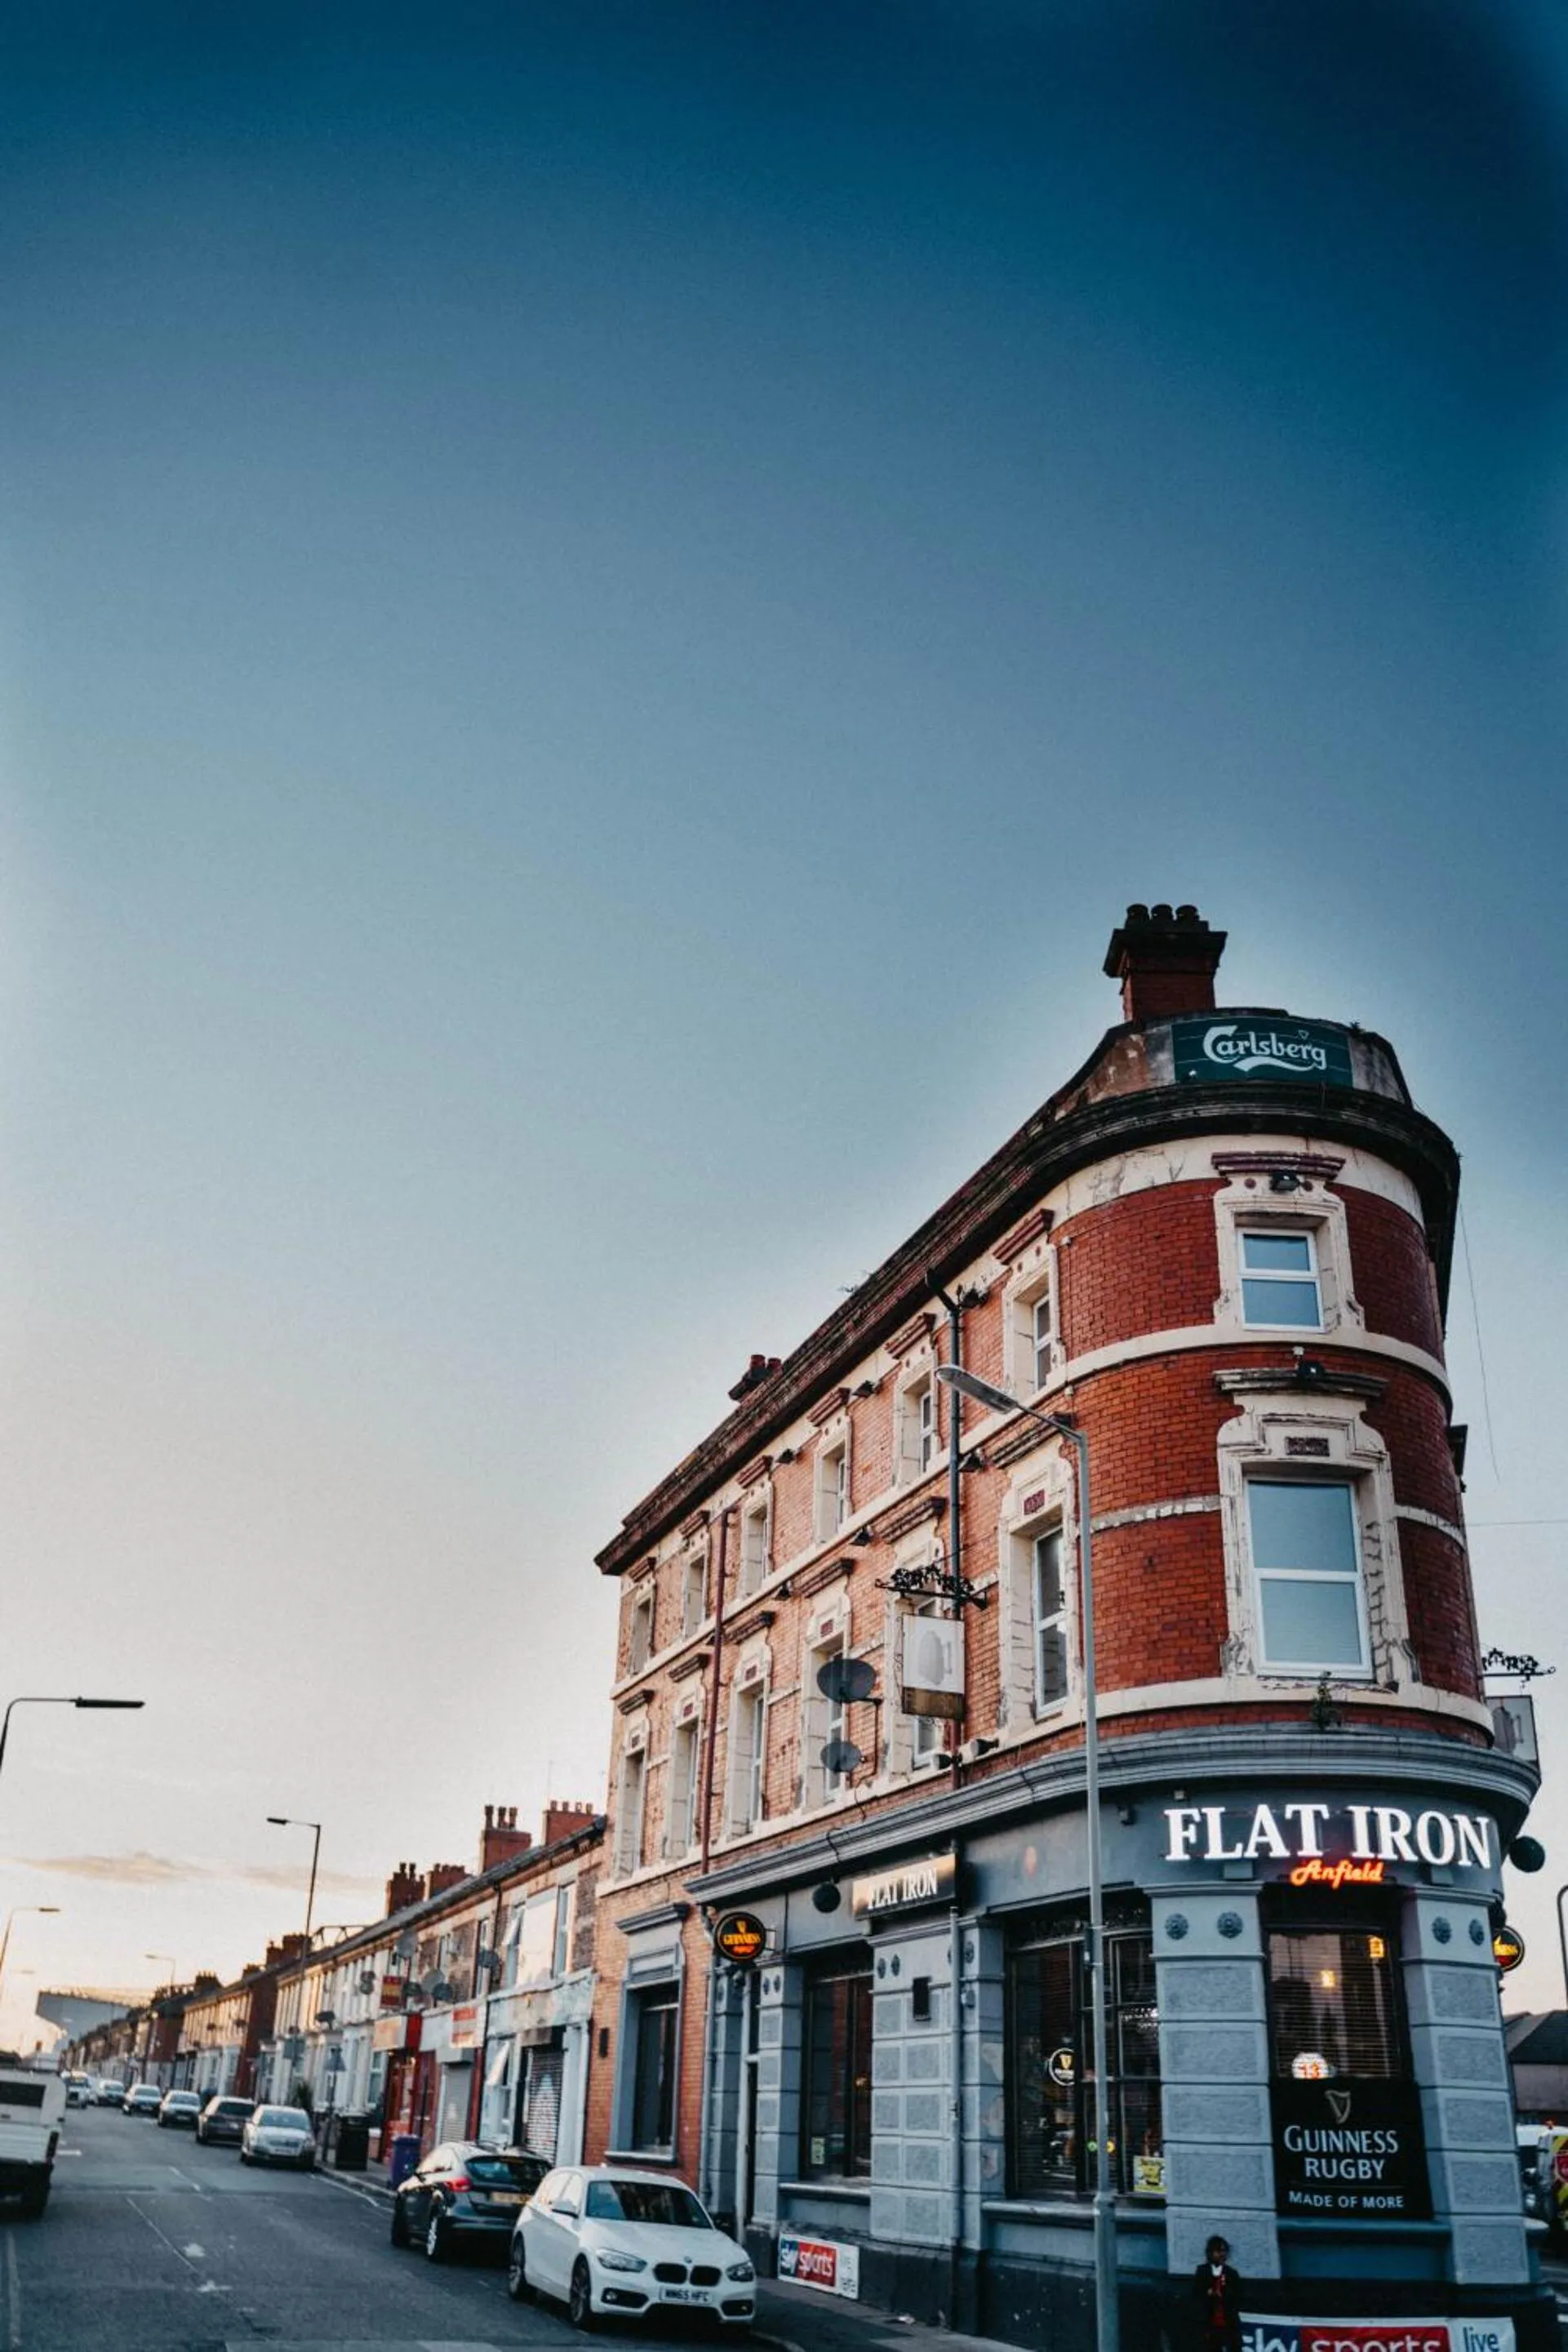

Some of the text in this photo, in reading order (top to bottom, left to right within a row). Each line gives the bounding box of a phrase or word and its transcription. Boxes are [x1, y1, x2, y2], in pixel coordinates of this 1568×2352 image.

[1202, 1025, 1328, 1070] Carlsberg
[1164, 1803, 1493, 1870] FLAT IRON
[868, 1867, 938, 1910] FLAT IRON
[1290, 1858, 1385, 1890] Anfield
[1283, 2124, 1400, 2154] GUINNESS
[1304, 2157, 1385, 2181] RUGBY
[1288, 2190, 1405, 2209] MADE OF MORE
[799, 2251, 833, 2279] sports
[1463, 2327, 1499, 2352] live
